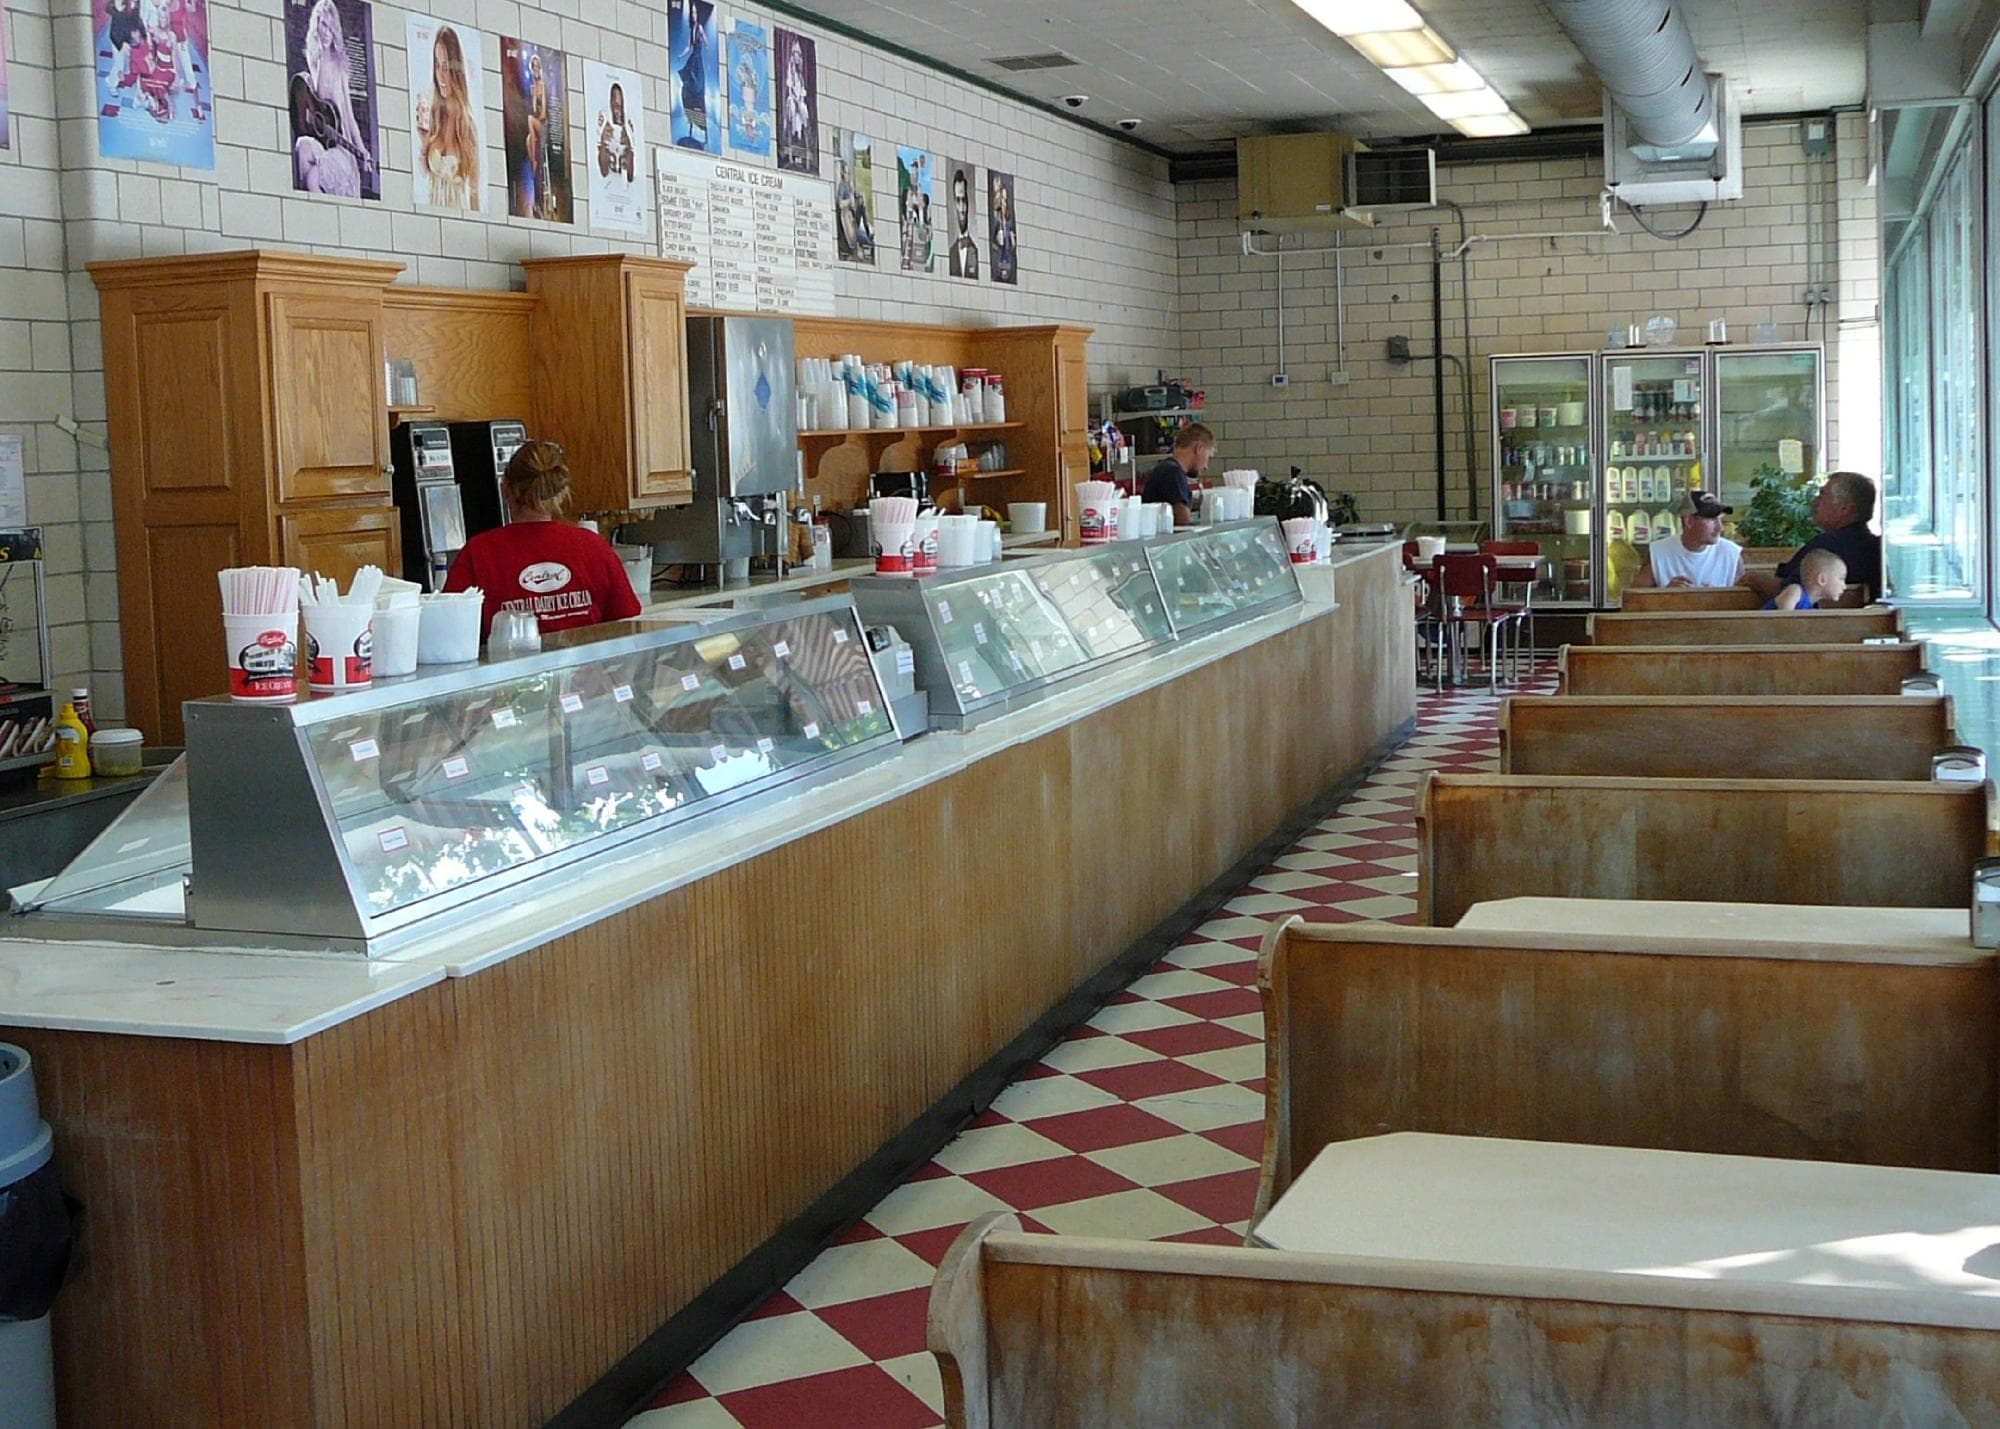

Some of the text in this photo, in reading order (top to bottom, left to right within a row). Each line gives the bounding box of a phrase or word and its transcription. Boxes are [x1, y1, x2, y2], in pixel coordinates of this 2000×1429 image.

[716, 167, 783, 189] CENTRAL ICE CREAM
[523, 569, 566, 584] Central
[534, 595, 556, 613] DAIRY
[557, 593, 569, 611] ICE
[569, 590, 592, 607] CREAM
